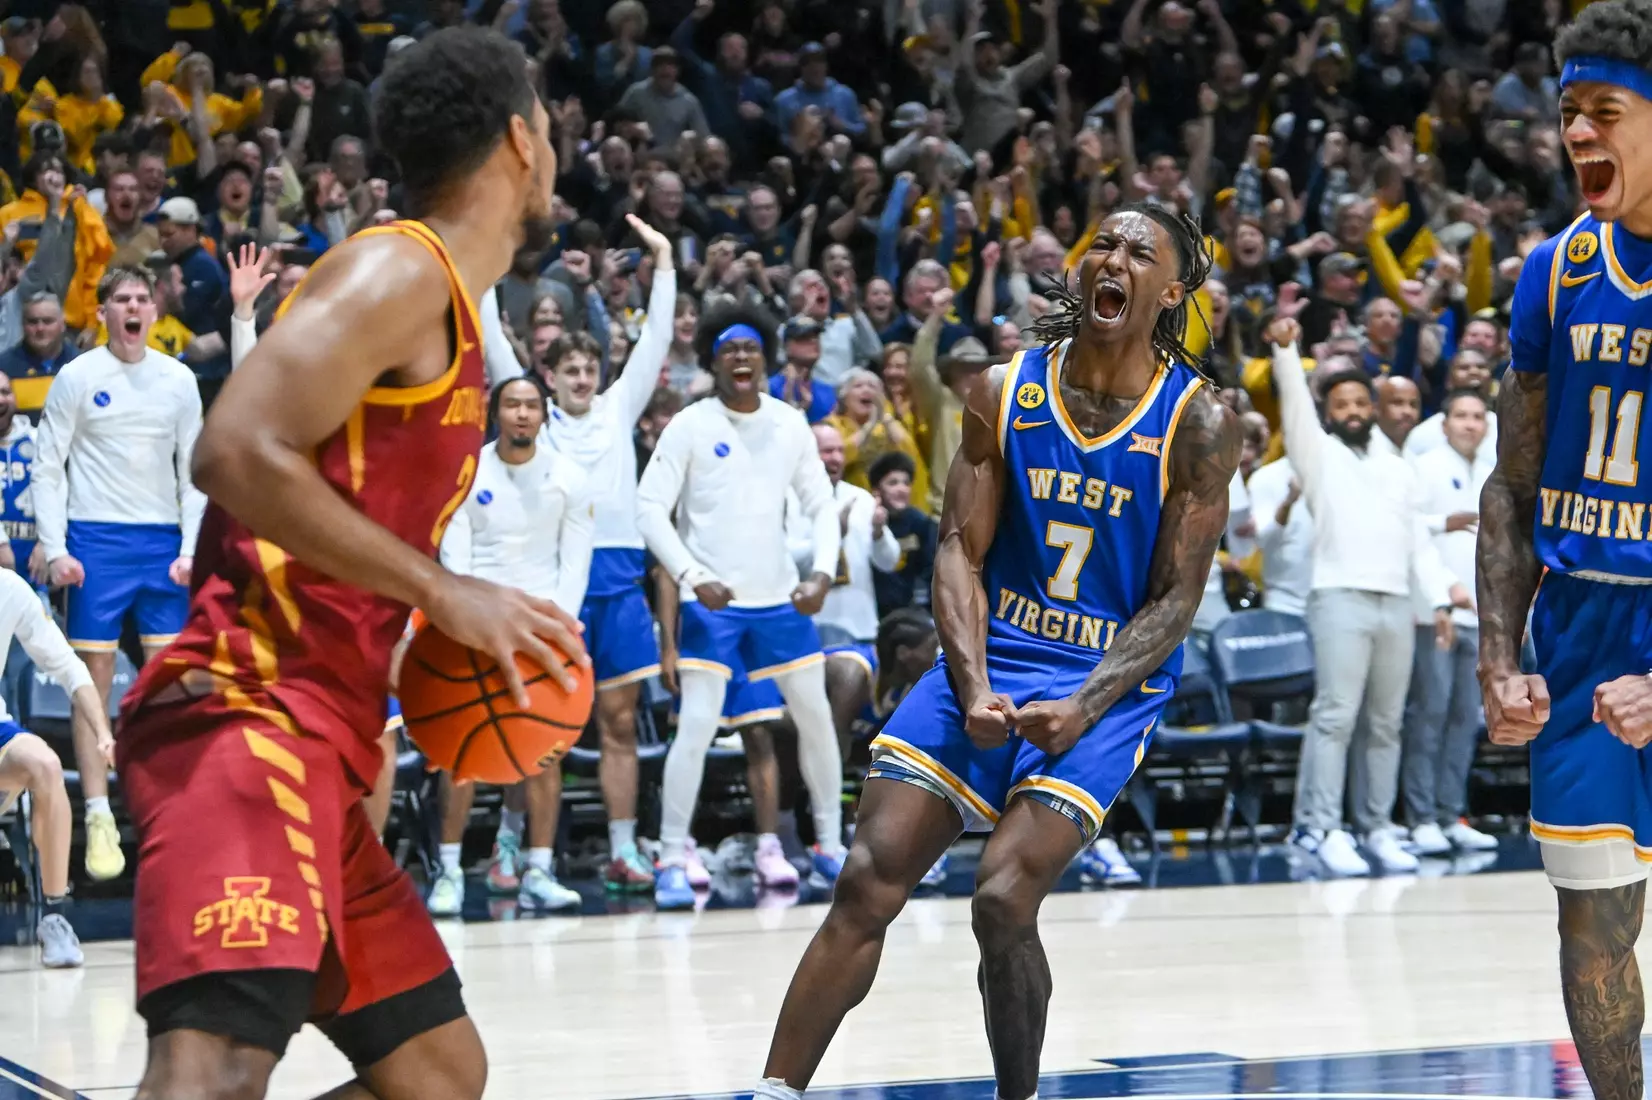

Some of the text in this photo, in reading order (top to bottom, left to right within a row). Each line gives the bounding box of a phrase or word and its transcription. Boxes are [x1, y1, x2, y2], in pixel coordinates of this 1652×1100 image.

[1571, 243, 1589, 256] 44
[1569, 323, 1652, 366] WES
[1020, 391, 1038, 404] 44
[1583, 385, 1644, 487] 11
[1027, 468, 1133, 518] WEST
[1045, 519, 1095, 602] 7
[995, 587, 1119, 651] VIRGINI
[193, 896, 300, 937] STATE
